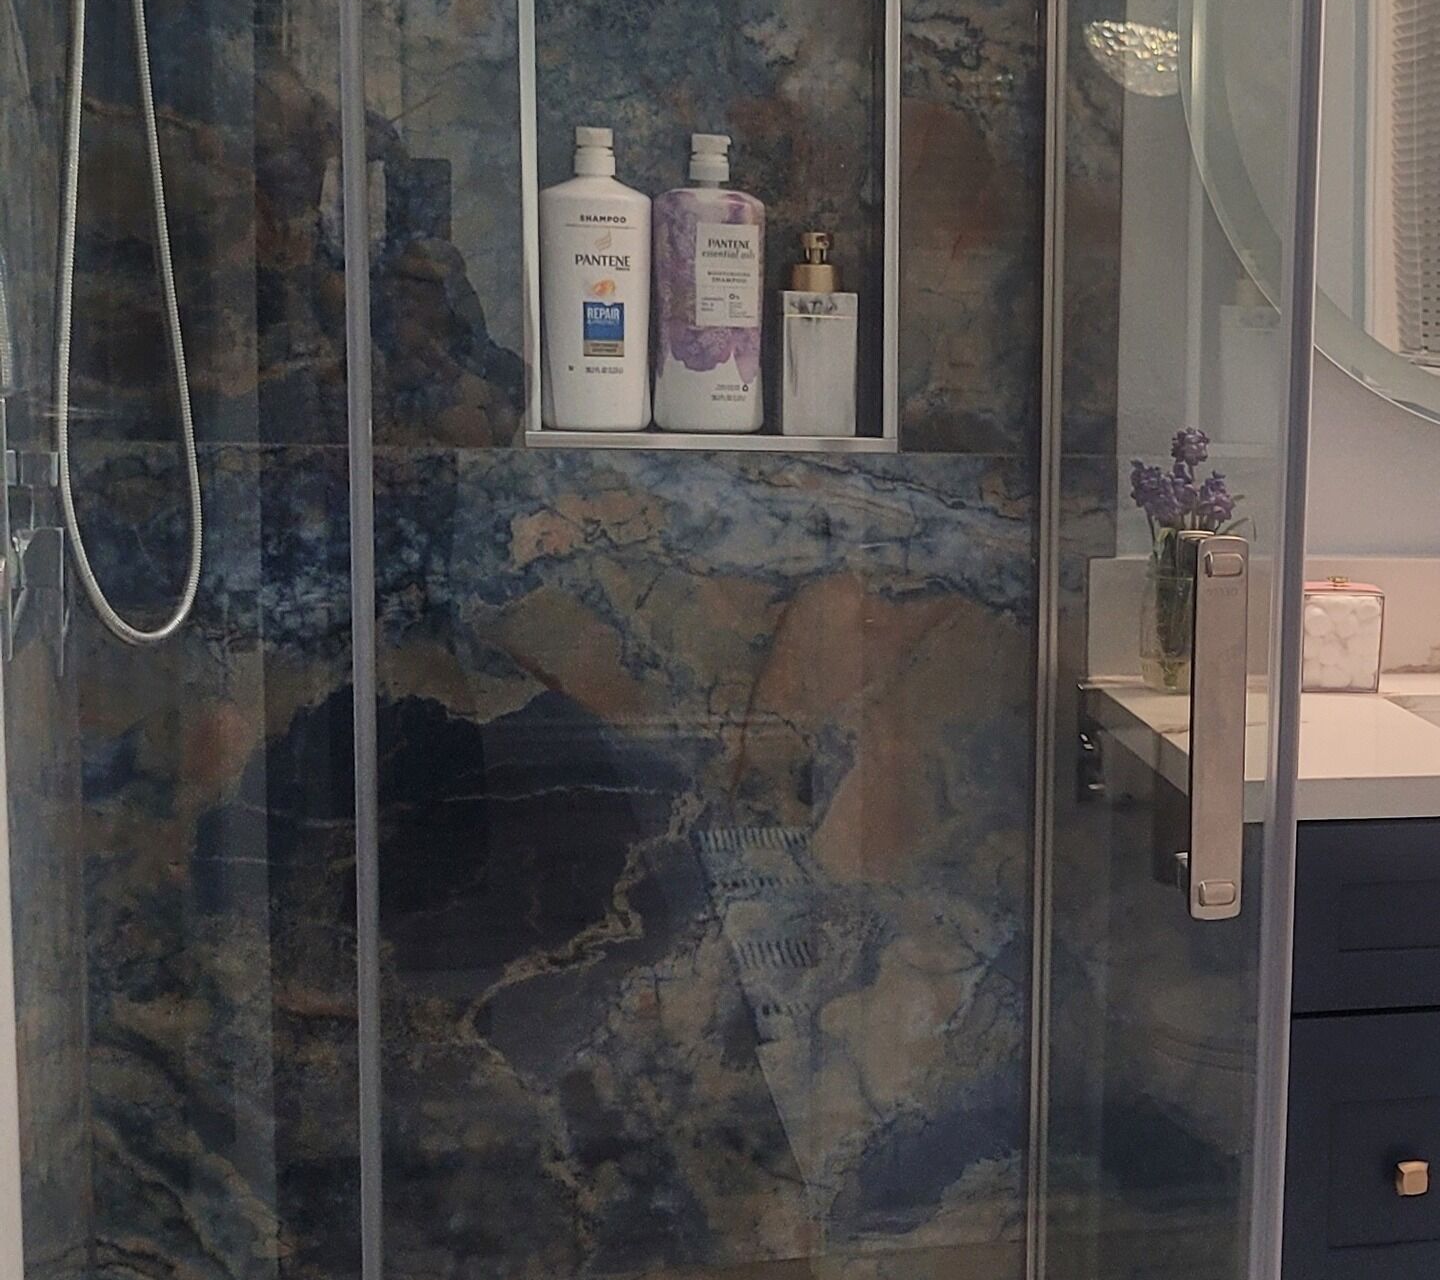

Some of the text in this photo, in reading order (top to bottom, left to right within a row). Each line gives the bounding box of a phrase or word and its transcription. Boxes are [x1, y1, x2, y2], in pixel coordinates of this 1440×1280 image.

[579, 214, 627, 224] SHAMPOO
[707, 238, 751, 250] PANTENE
[701, 248, 740, 259] essential
[574, 253, 631, 267] PANTENE
[586, 307, 621, 320] REPAIR
